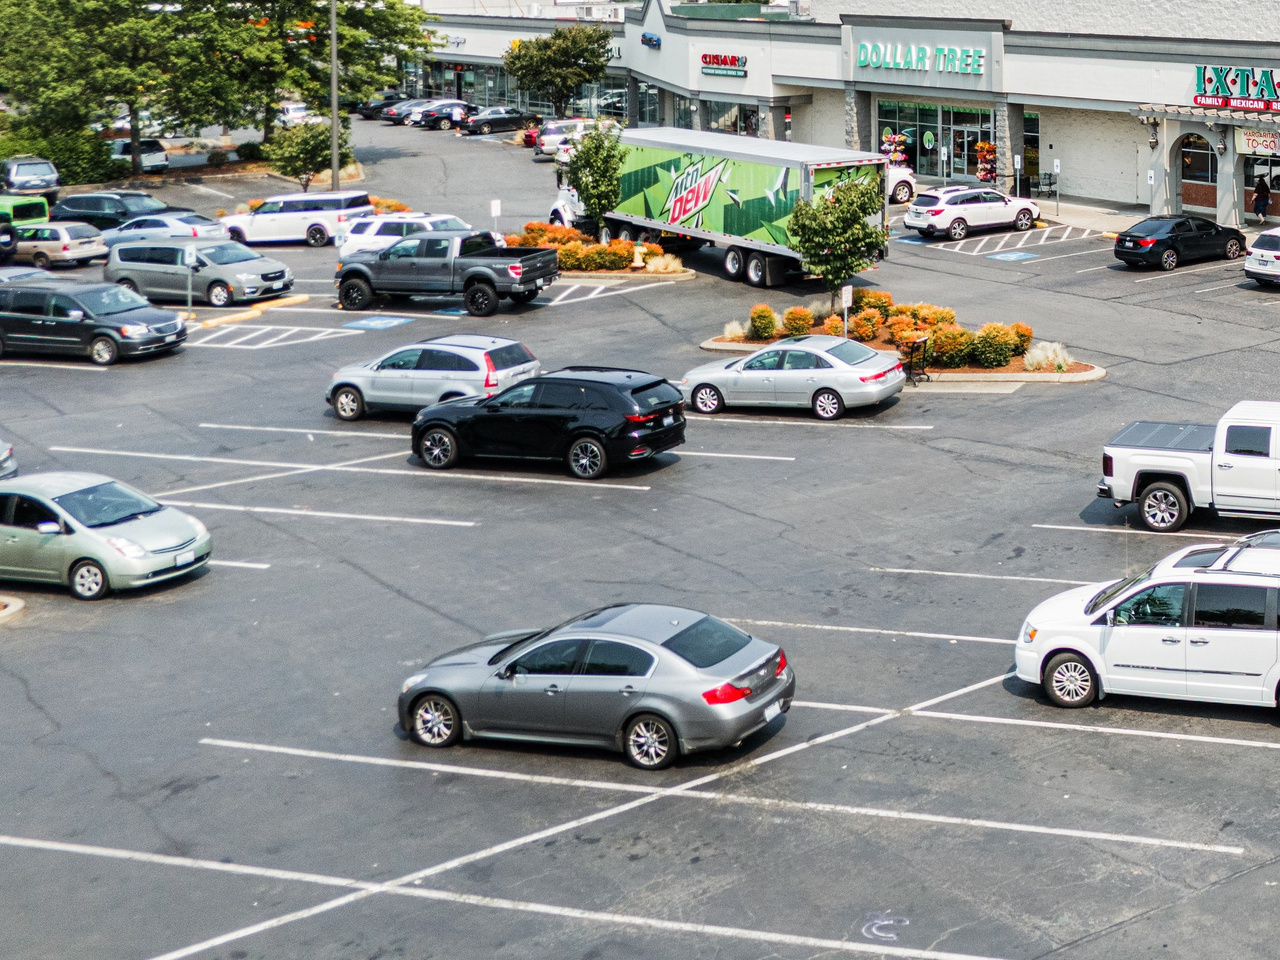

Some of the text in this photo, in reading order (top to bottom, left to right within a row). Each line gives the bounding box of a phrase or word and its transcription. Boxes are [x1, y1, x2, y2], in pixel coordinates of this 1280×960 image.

[857, 42, 985, 75] DOLLAR TREE
[1197, 96, 1223, 106] FAMILY
[1230, 99, 1264, 109] MEXICAN
[1243, 131, 1278, 139] MARGARITAS
